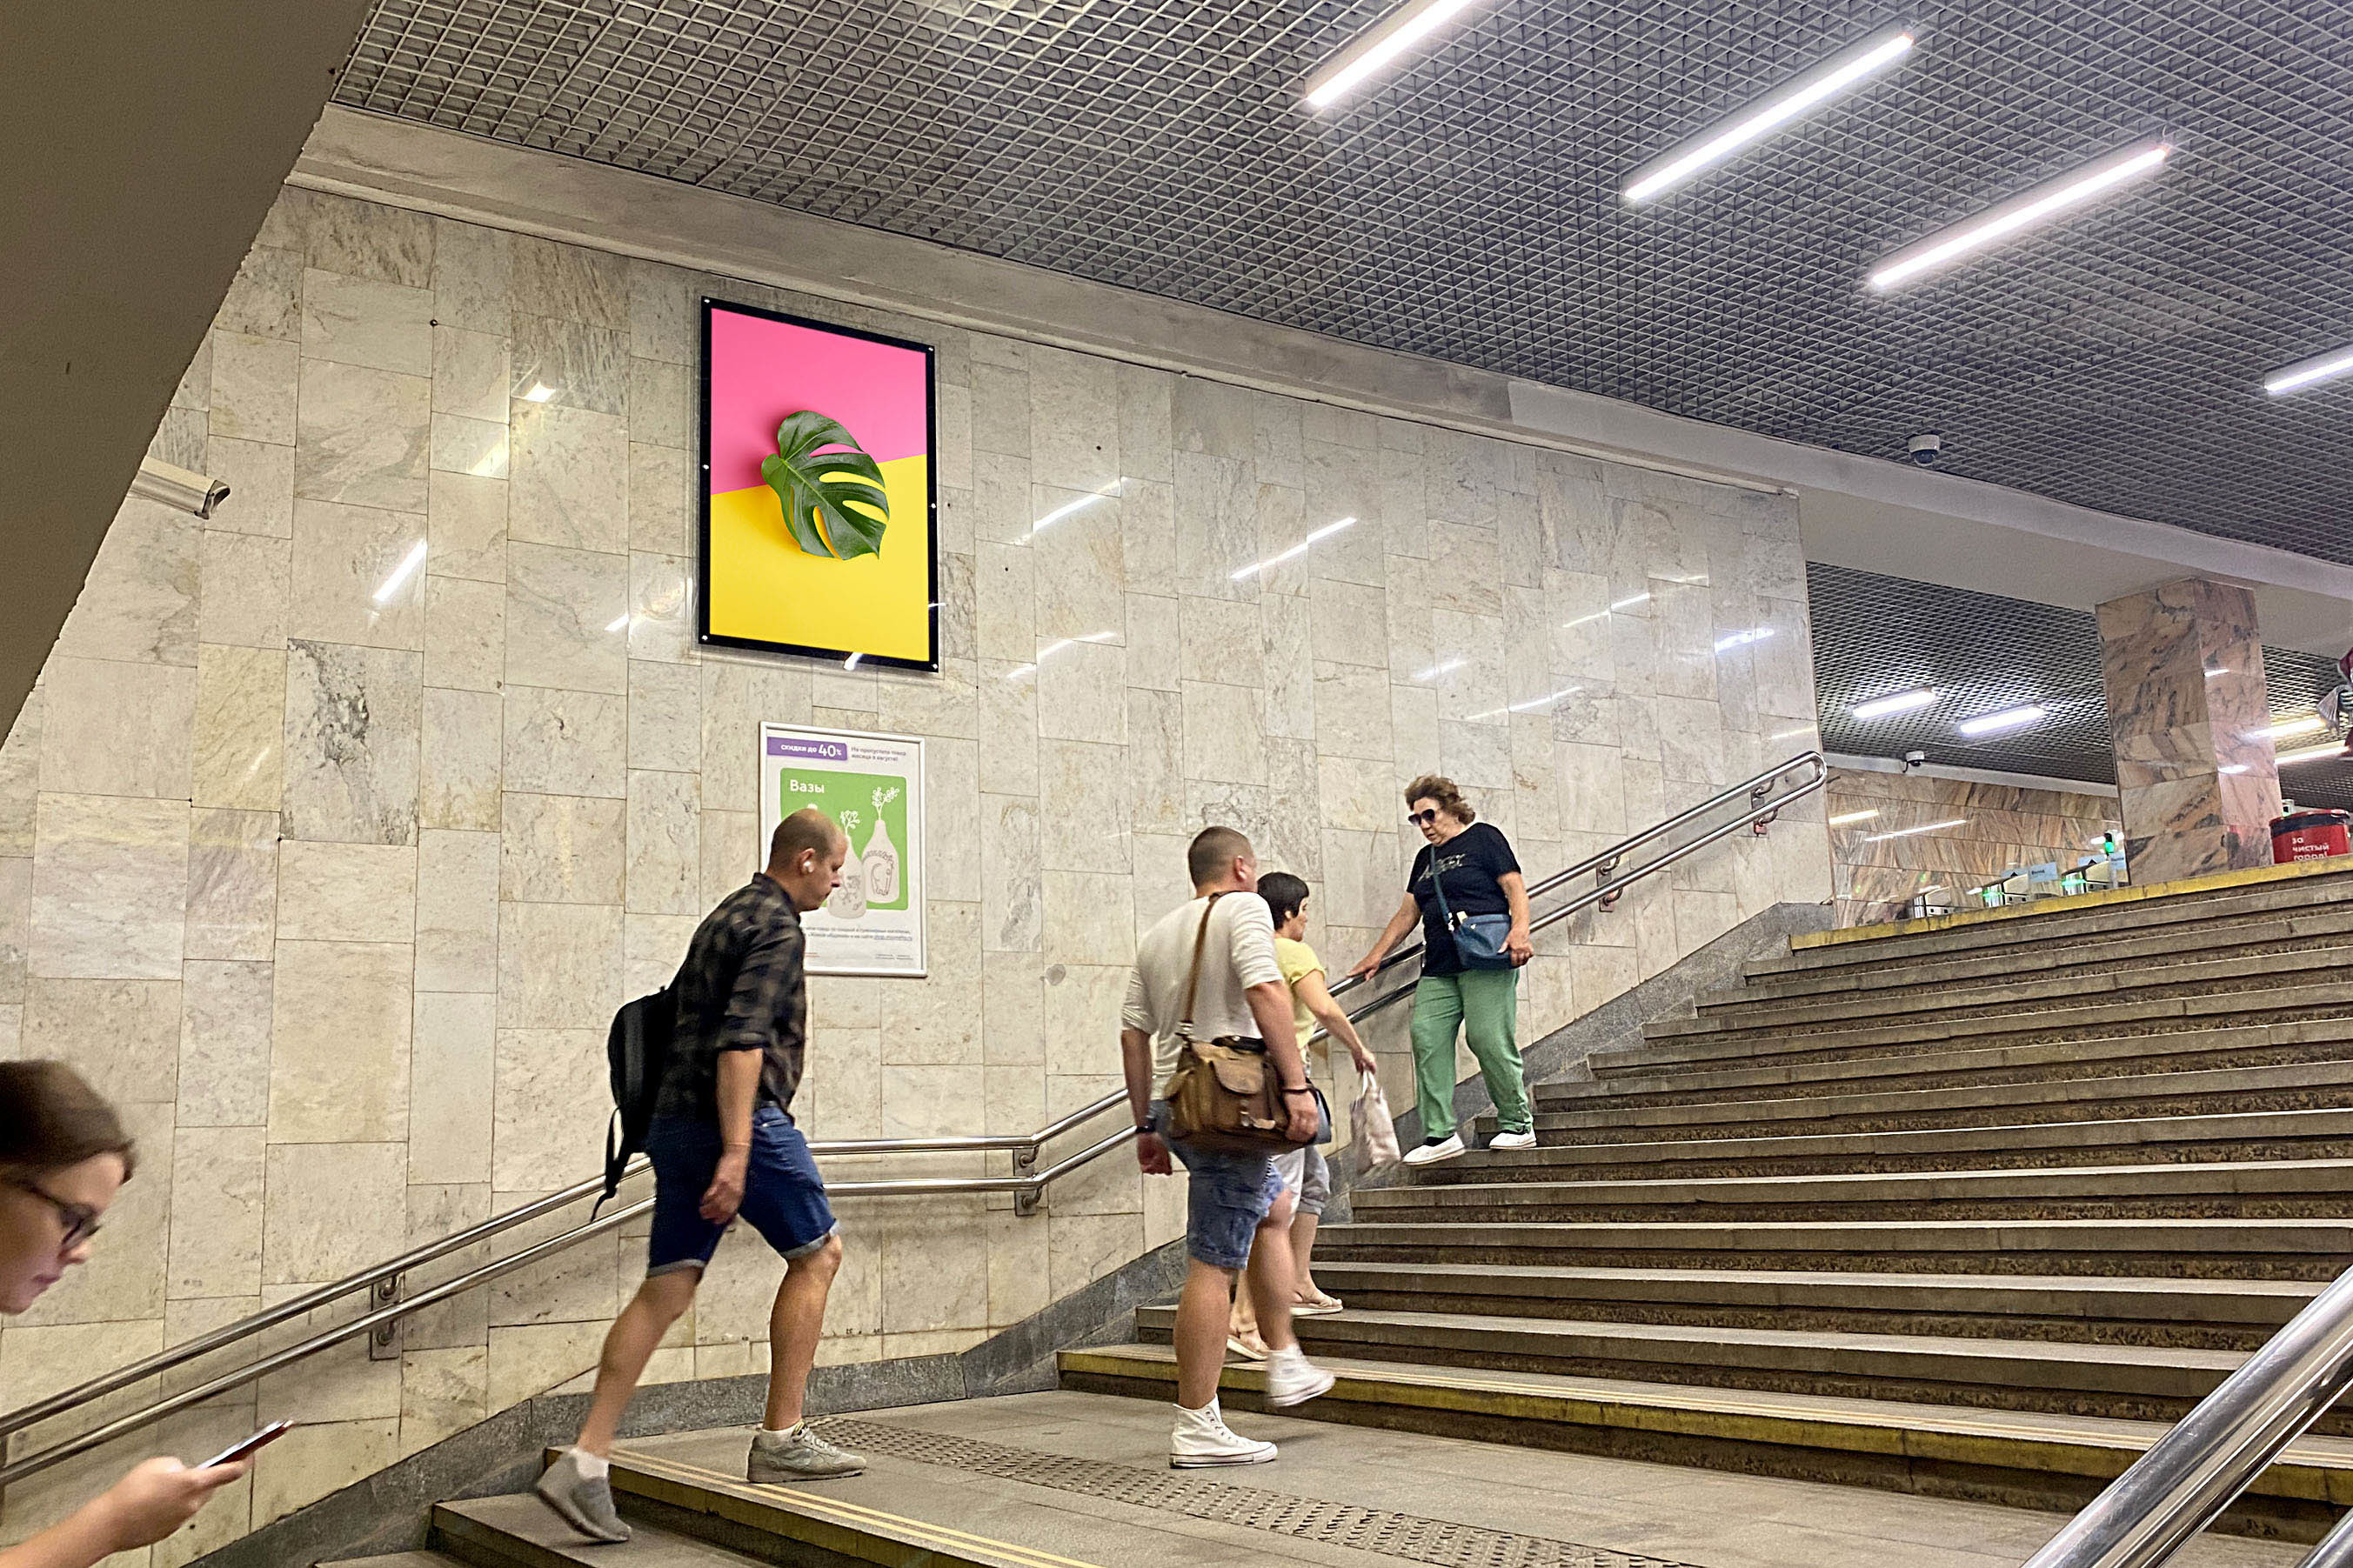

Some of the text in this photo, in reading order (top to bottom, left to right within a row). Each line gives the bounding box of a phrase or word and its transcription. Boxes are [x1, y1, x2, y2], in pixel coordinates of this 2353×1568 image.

[780, 744, 807, 752] скидки
[789, 778, 826, 794] Вазы
[2291, 843, 2330, 853] чистый
